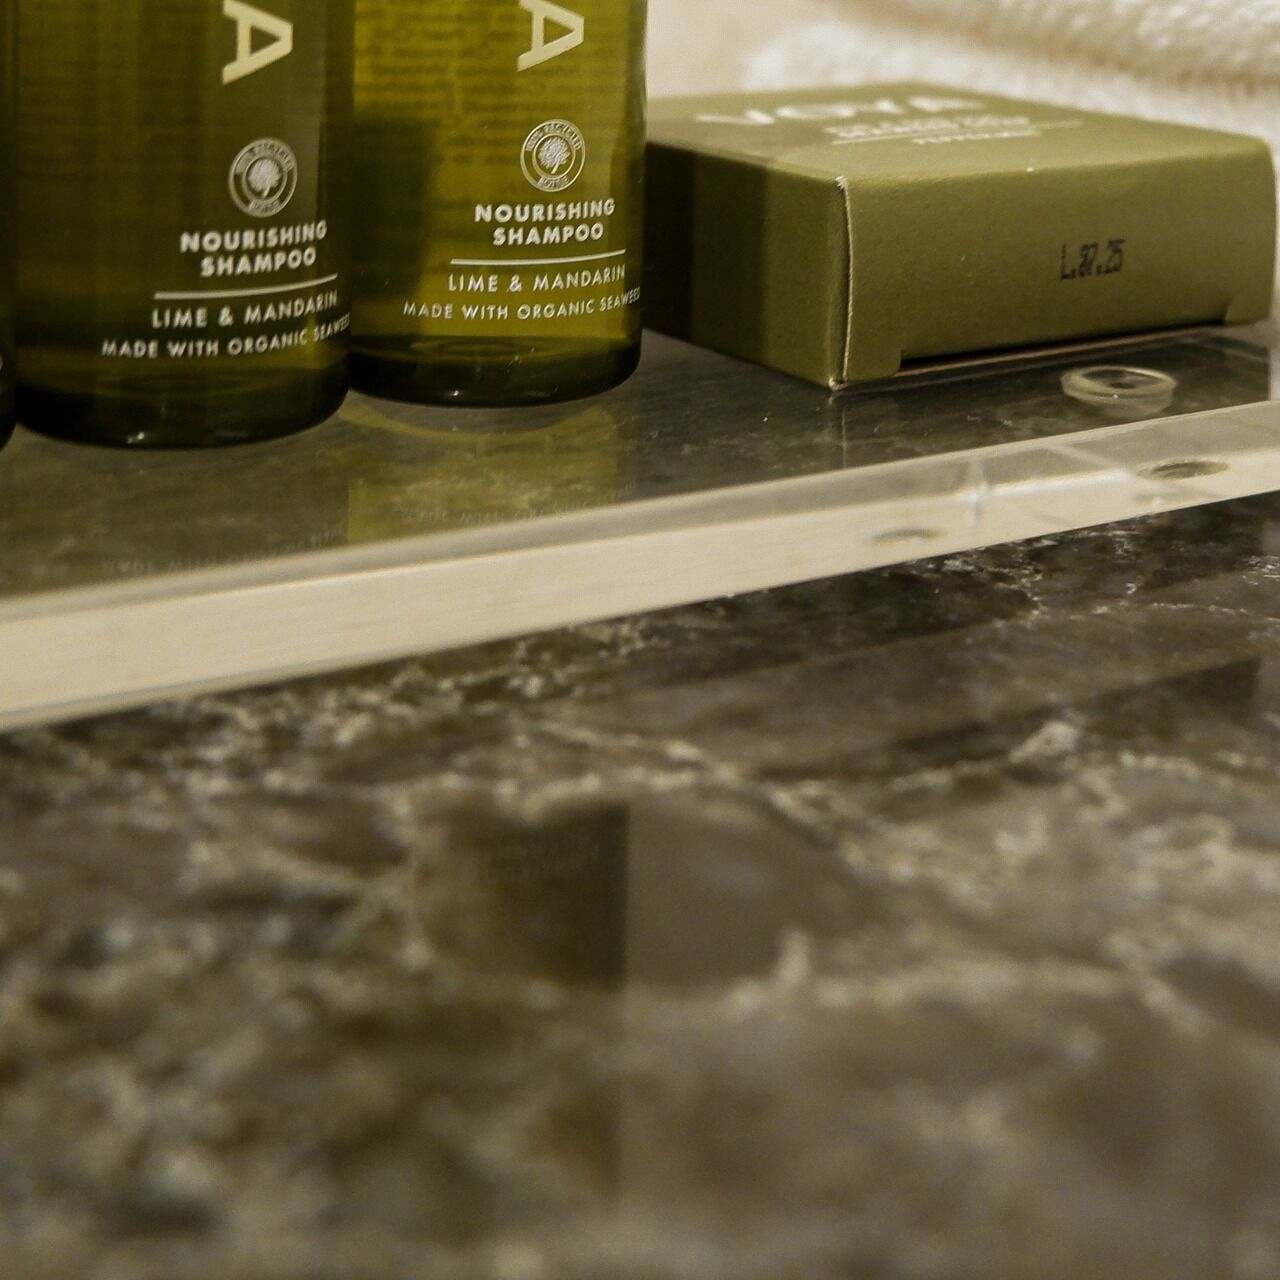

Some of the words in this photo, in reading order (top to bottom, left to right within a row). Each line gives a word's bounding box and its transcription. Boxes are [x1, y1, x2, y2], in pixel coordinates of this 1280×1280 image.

[474, 197, 616, 223] NOURISHING
[179, 220, 328, 253] NOURISHING
[492, 222, 604, 246] SHAMPOO
[200, 246, 317, 277] SHAMPOO
[448, 273, 498, 293] LIME
[507, 274, 523, 293] &
[532, 263, 626, 292] MANDARIN
[151, 306, 208, 329] LIME
[218, 305, 234, 327] &
[244, 288, 338, 324] MANDARIN
[403, 300, 454, 319] MADE
[461, 303, 508, 321] WITH
[517, 297, 595, 320] ORGANIC
[101, 338, 158, 359] MADE
[167, 339, 219, 358] WITH
[227, 327, 309, 356] ORGANIC
